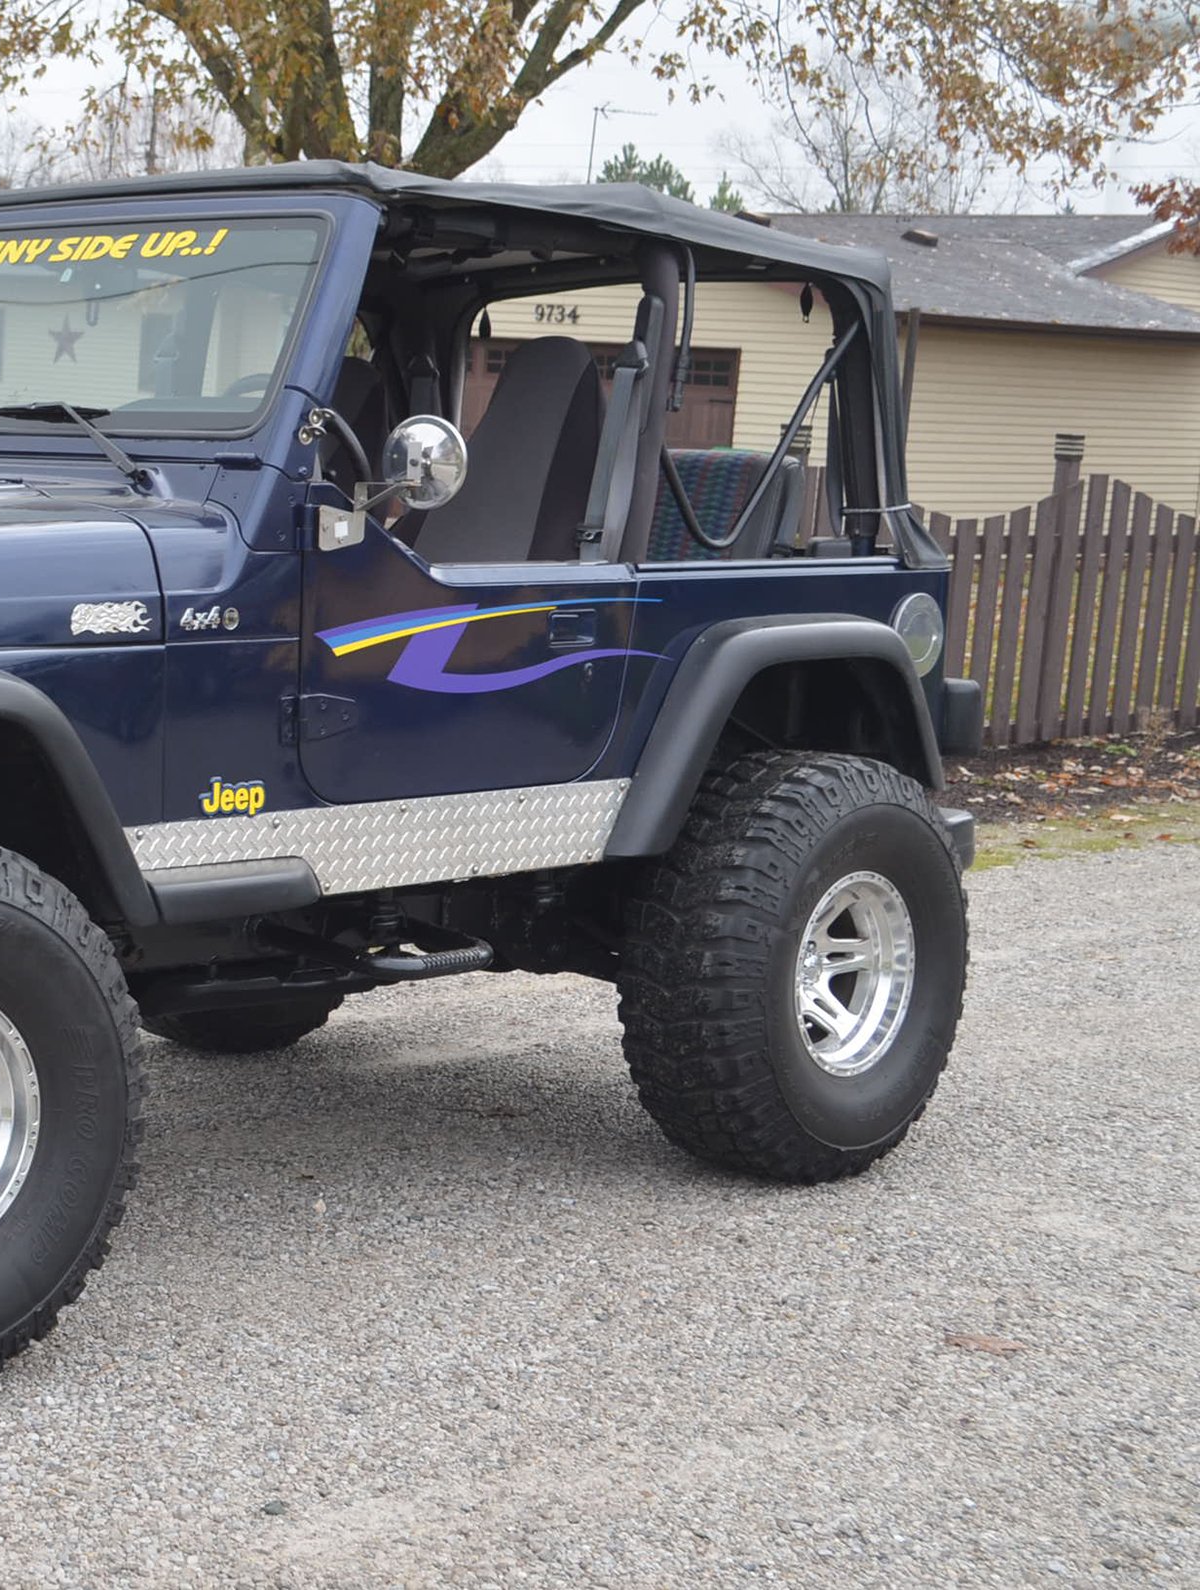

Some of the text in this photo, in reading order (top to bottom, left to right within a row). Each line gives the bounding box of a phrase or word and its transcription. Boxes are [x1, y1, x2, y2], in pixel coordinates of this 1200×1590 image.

[48, 233, 140, 263] SIDE
[534, 303, 580, 324] 9734
[180, 605, 221, 631] 4x4
[200, 778, 265, 816] Jeep
[71, 1063, 100, 1142] PRO
